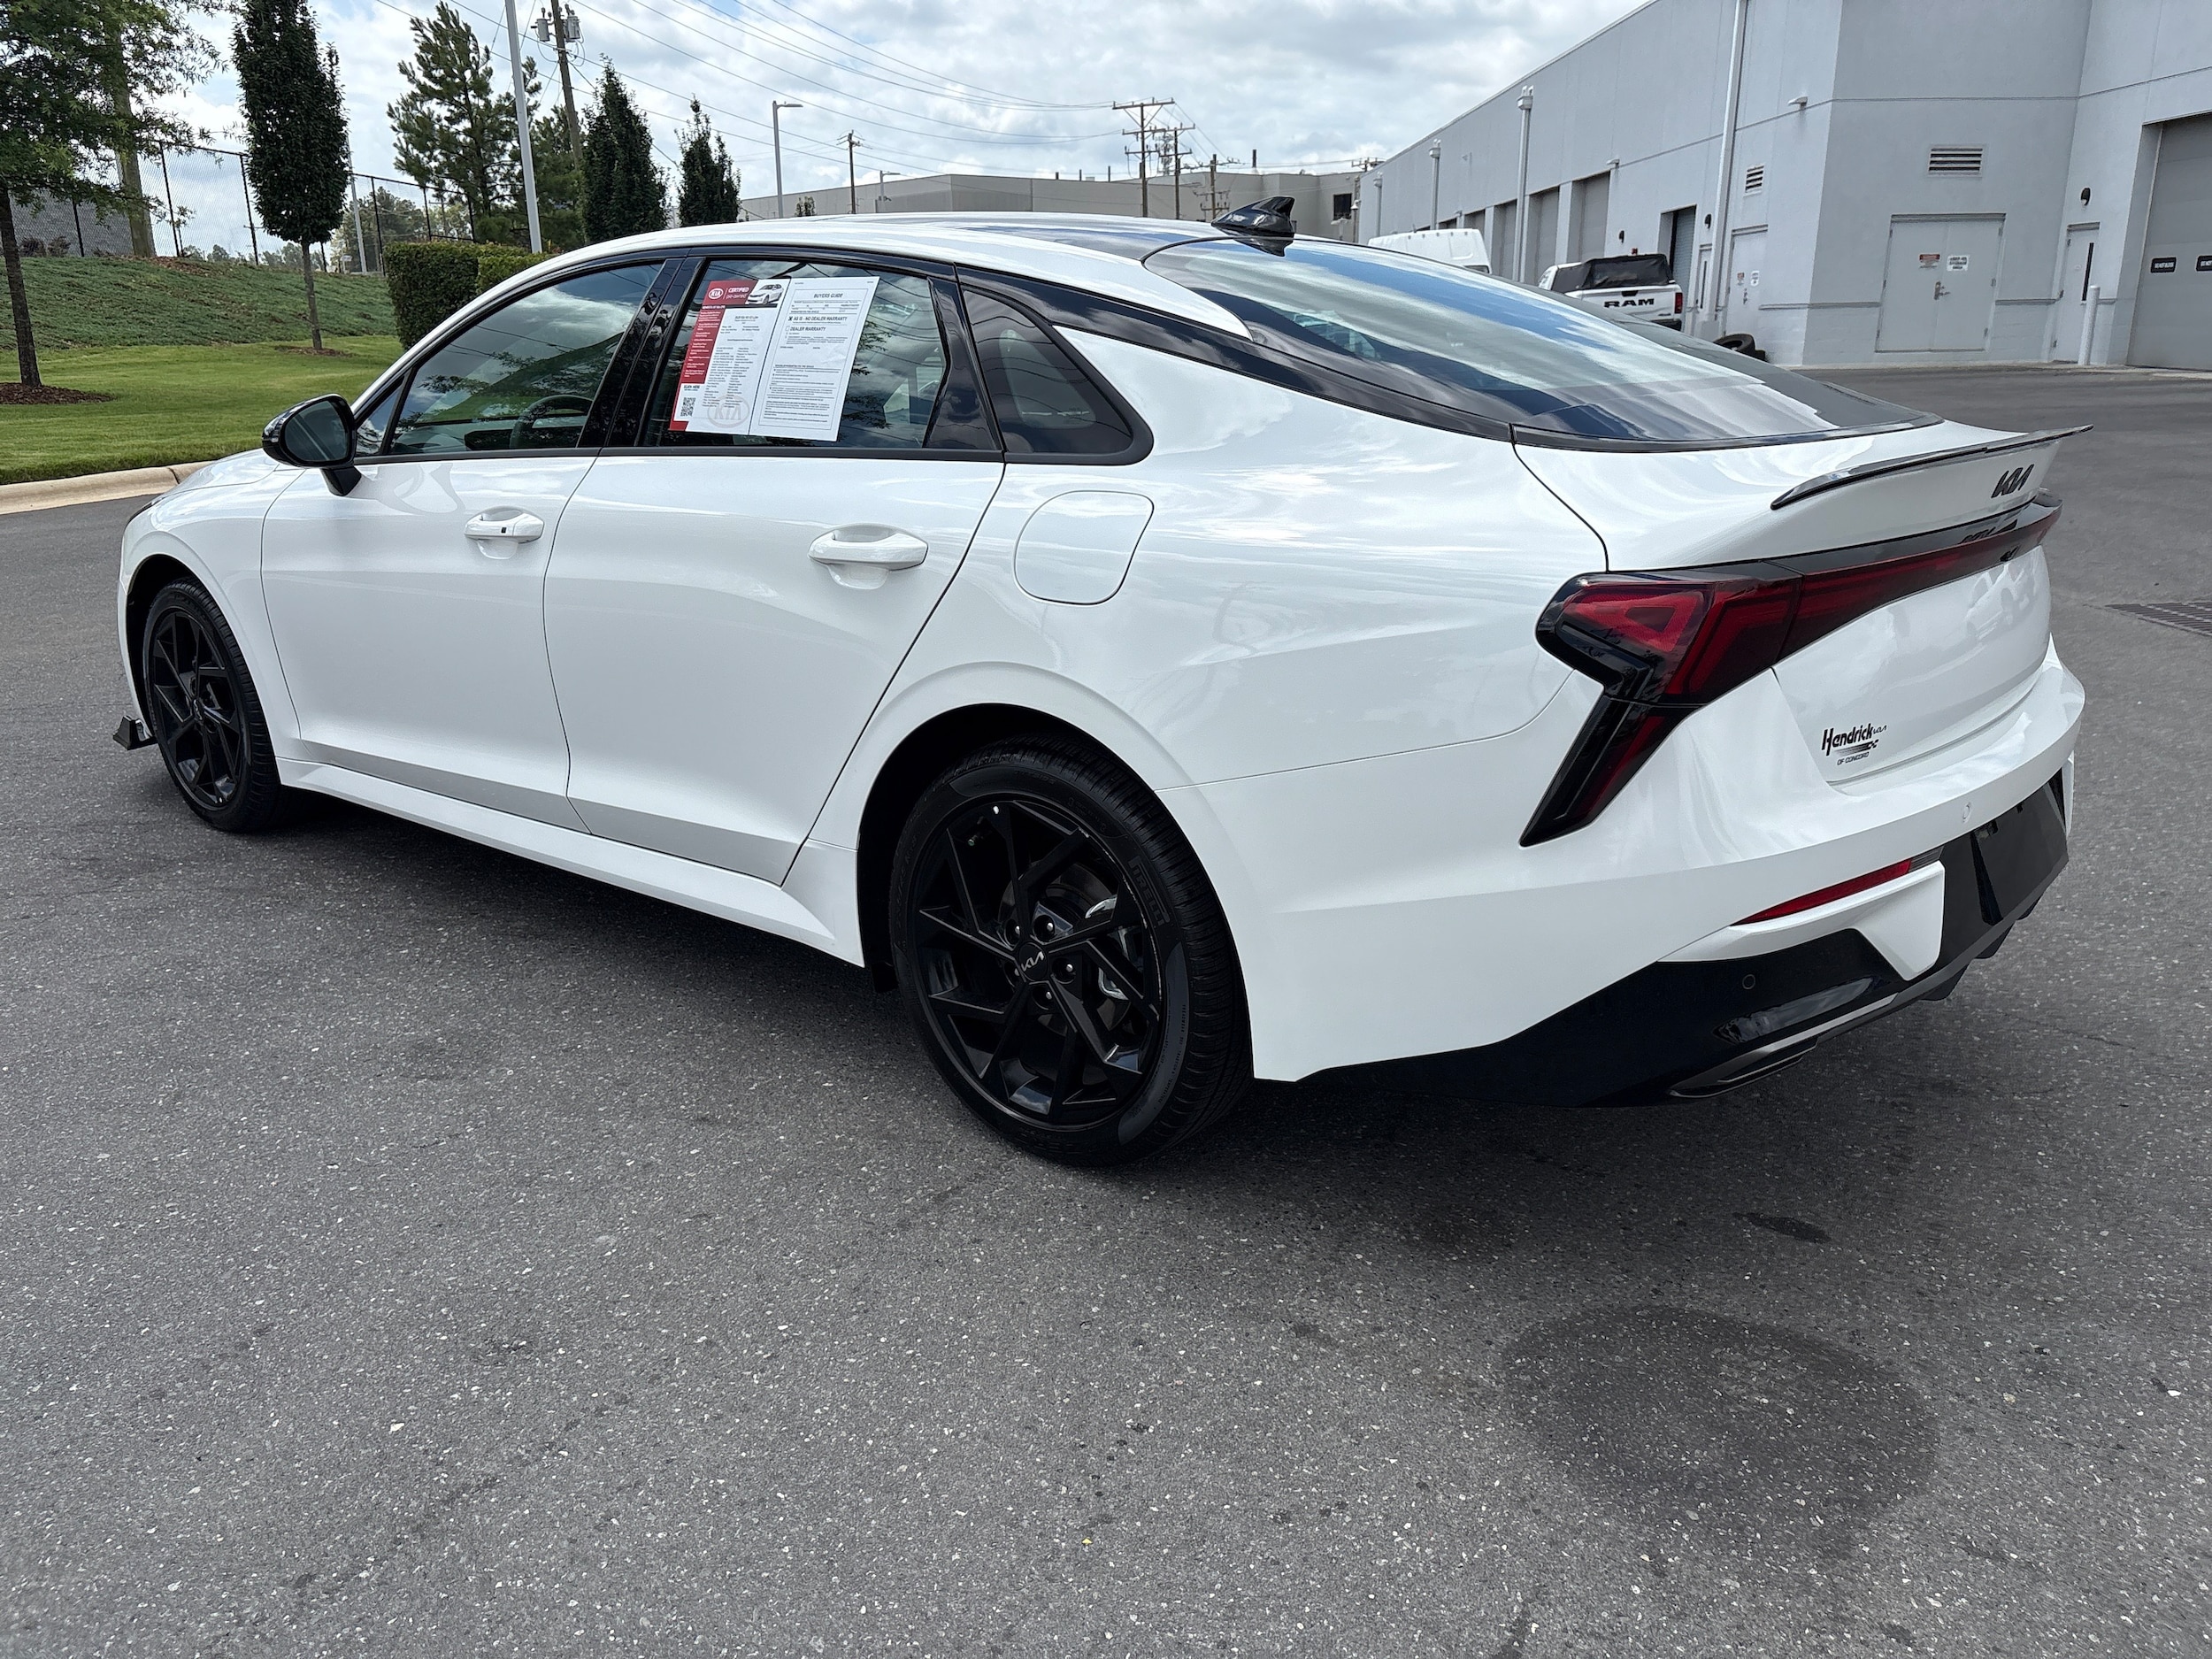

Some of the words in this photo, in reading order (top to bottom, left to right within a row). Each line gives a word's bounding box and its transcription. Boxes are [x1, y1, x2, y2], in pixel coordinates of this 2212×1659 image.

[710, 289, 722, 298] KIA
[1604, 298, 1655, 308] RAM
[1821, 723, 1874, 757] Hendrick
[1845, 751, 1870, 764] CONCORD
[1127, 855, 1170, 926] PIRELLI
